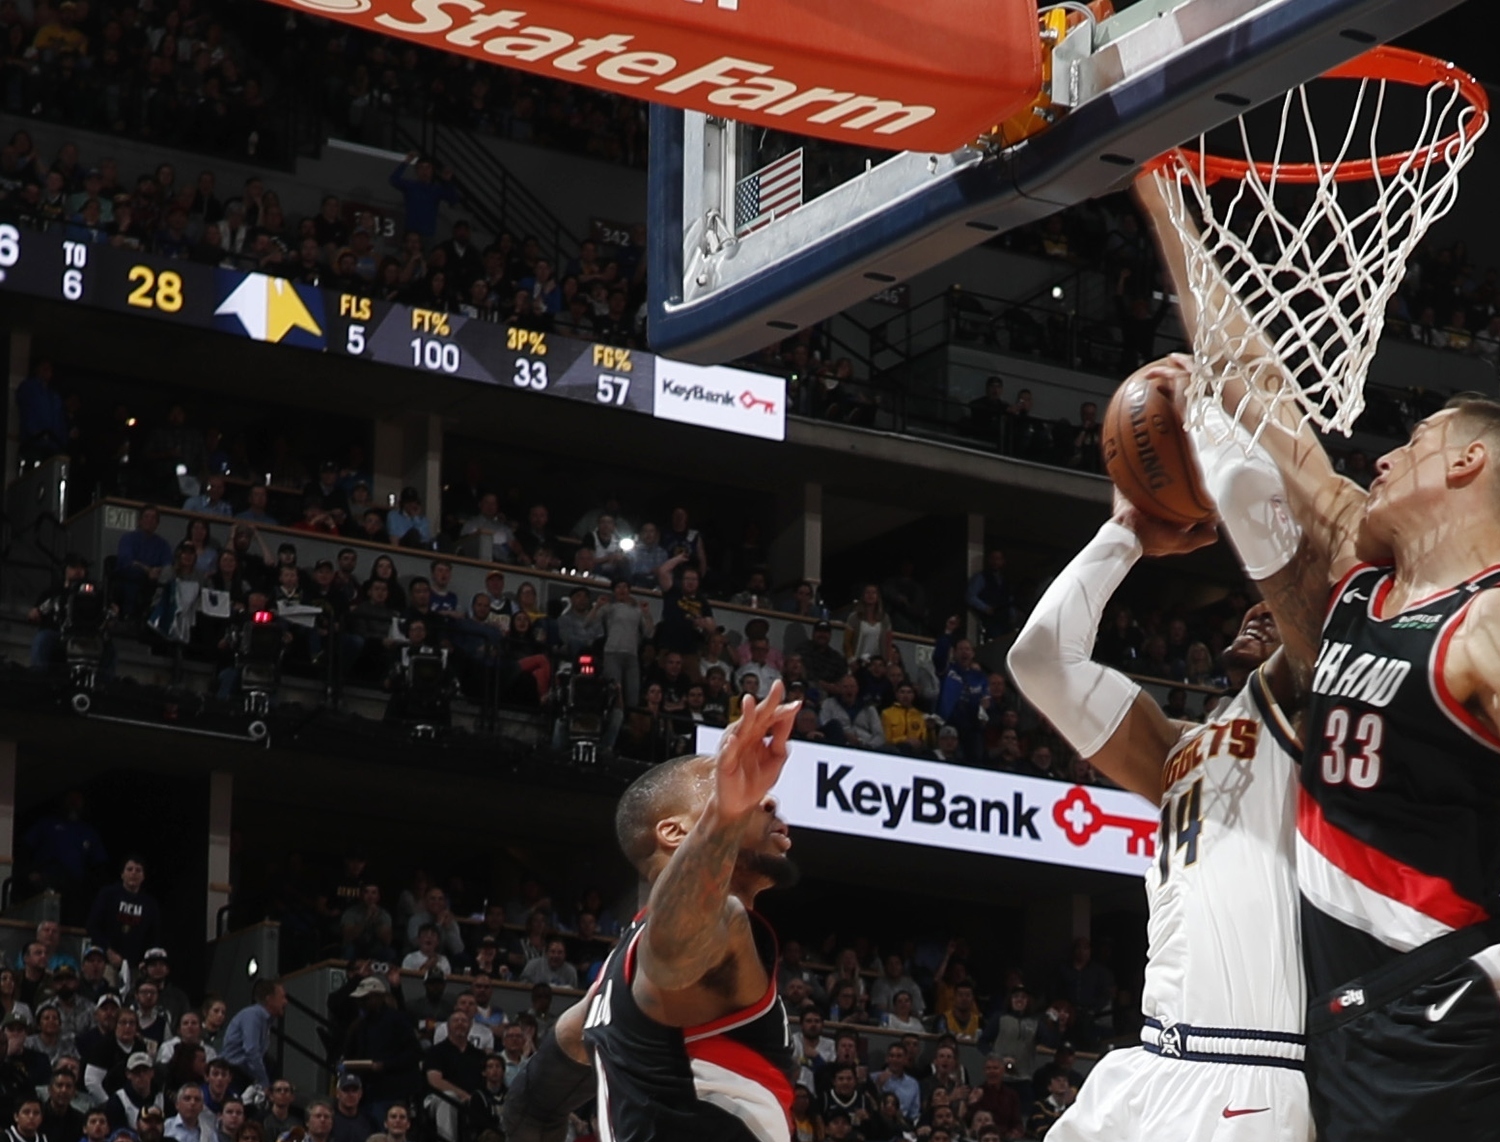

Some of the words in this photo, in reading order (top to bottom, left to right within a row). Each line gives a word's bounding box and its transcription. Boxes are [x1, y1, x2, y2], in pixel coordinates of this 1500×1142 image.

[63, 240, 87, 268] TO
[62, 270, 83, 301] 6
[127, 265, 183, 312] 28
[340, 294, 372, 320] FLS
[411, 308, 450, 337] FT%
[346, 324, 366, 355] 5
[410, 337, 460, 373] 100
[506, 327, 547, 356] 3P%
[513, 357, 548, 391] 33
[592, 344, 633, 373] FG%
[596, 374, 630, 406] 57
[662, 378, 736, 408] KeyBank
[105, 508, 136, 529] EXIT
[1321, 707, 1384, 789] 33
[816, 761, 1042, 840] KeyBank
